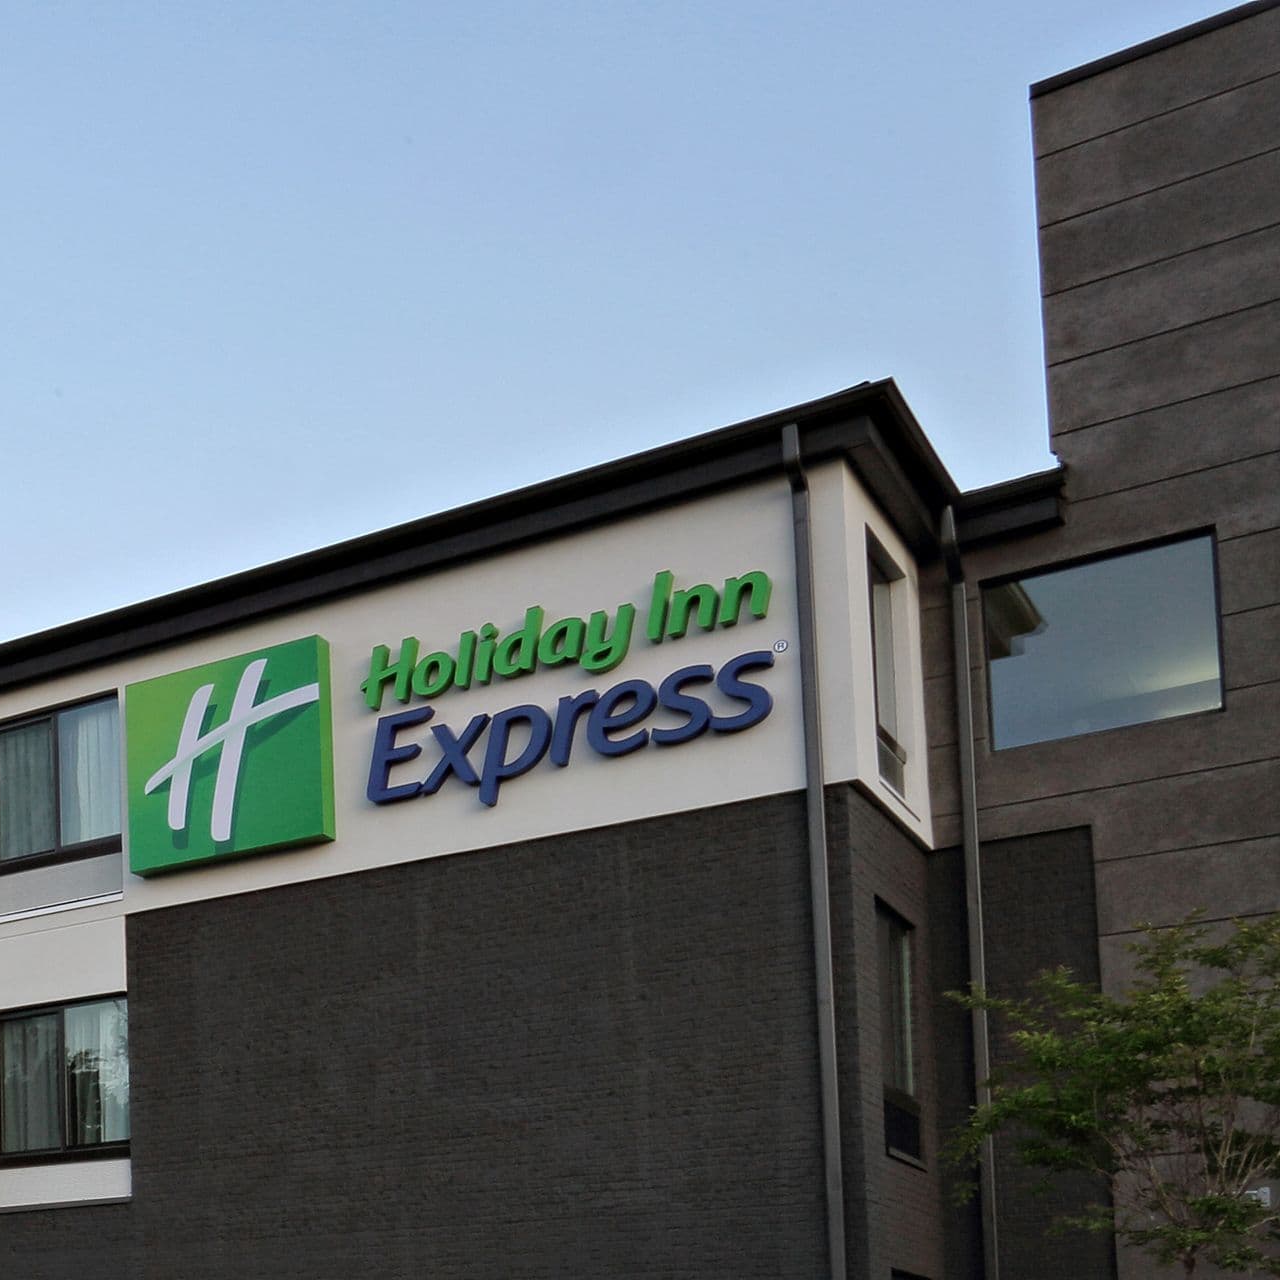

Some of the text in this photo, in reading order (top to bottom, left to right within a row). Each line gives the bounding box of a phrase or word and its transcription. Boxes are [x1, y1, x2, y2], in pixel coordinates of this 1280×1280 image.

[360, 570, 772, 711] Holiday Inn
[366, 650, 776, 807] Express
